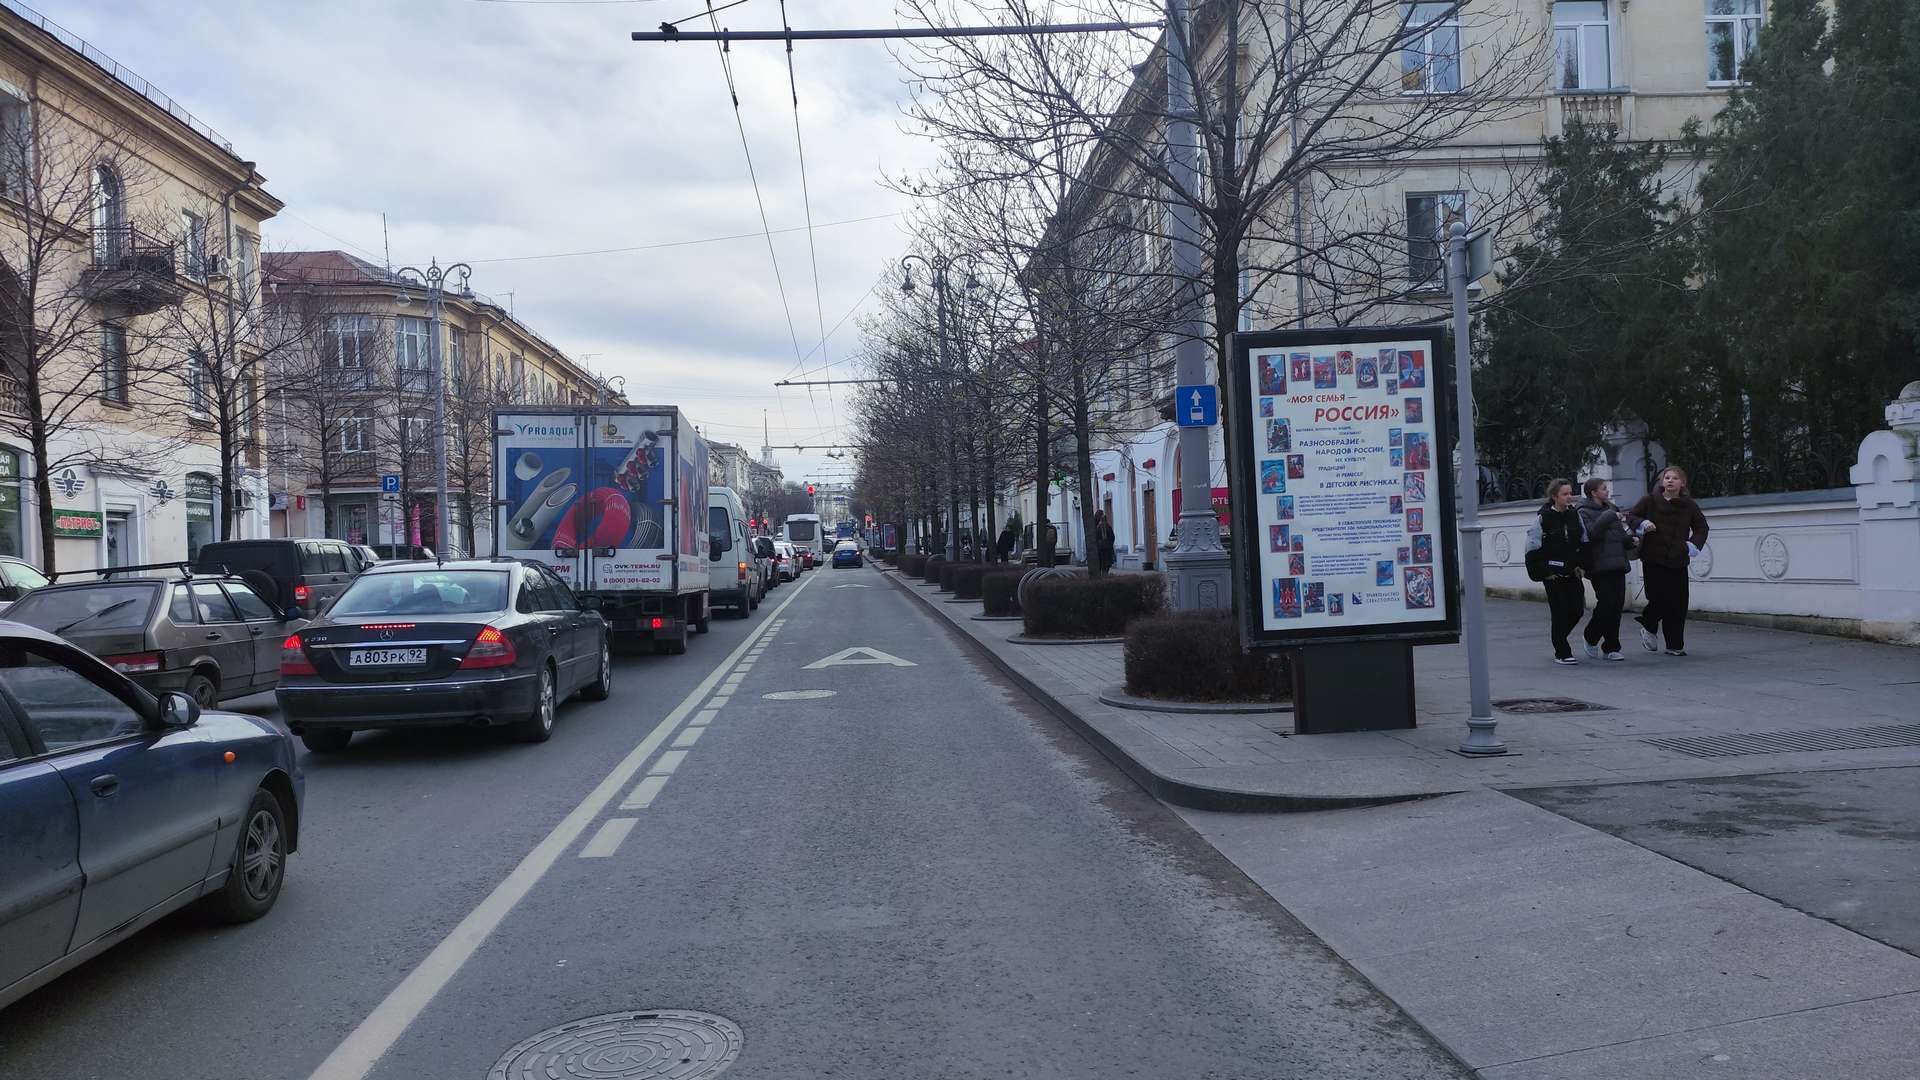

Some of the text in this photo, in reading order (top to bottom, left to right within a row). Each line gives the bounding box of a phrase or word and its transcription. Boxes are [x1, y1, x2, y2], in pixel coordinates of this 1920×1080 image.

[1286, 395, 1314, 404] «МОЯ
[1315, 393, 1346, 403] СЕМЬЯ
[1314, 404, 1400, 423] РОССИЯ»
[528, 426, 575, 436] PRO AQUA
[1299, 438, 1360, 447] РАЗНООБРАЗИЕ
[1315, 447, 1352, 456] НАРОДОВ
[386, 476, 398, 490] P
[1319, 481, 1325, 489] В
[1325, 480, 1358, 489] ДЕТСКИХ
[56, 515, 102, 531] «ПАТРИОТ»
[409, 649, 423, 659] 92
